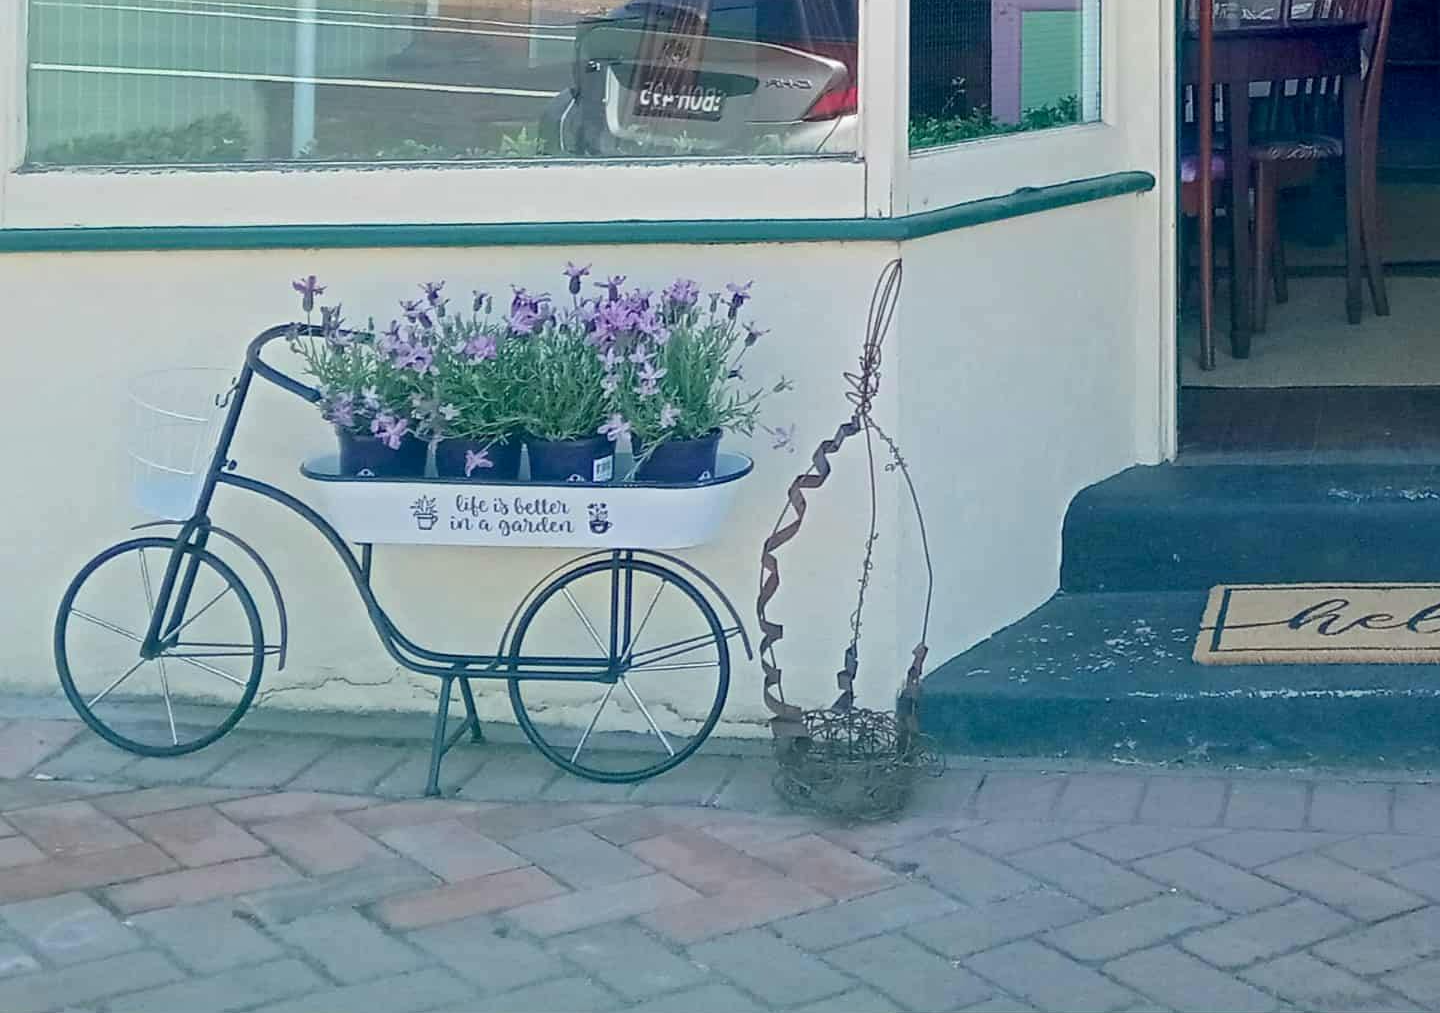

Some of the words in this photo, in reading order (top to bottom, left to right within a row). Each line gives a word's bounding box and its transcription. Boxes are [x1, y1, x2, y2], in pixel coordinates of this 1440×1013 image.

[455, 494, 489, 517] life
[493, 497, 510, 516] is
[513, 497, 571, 516] better
[449, 515, 474, 531] in
[478, 519, 493, 532] a
[497, 516, 575, 537] garden
